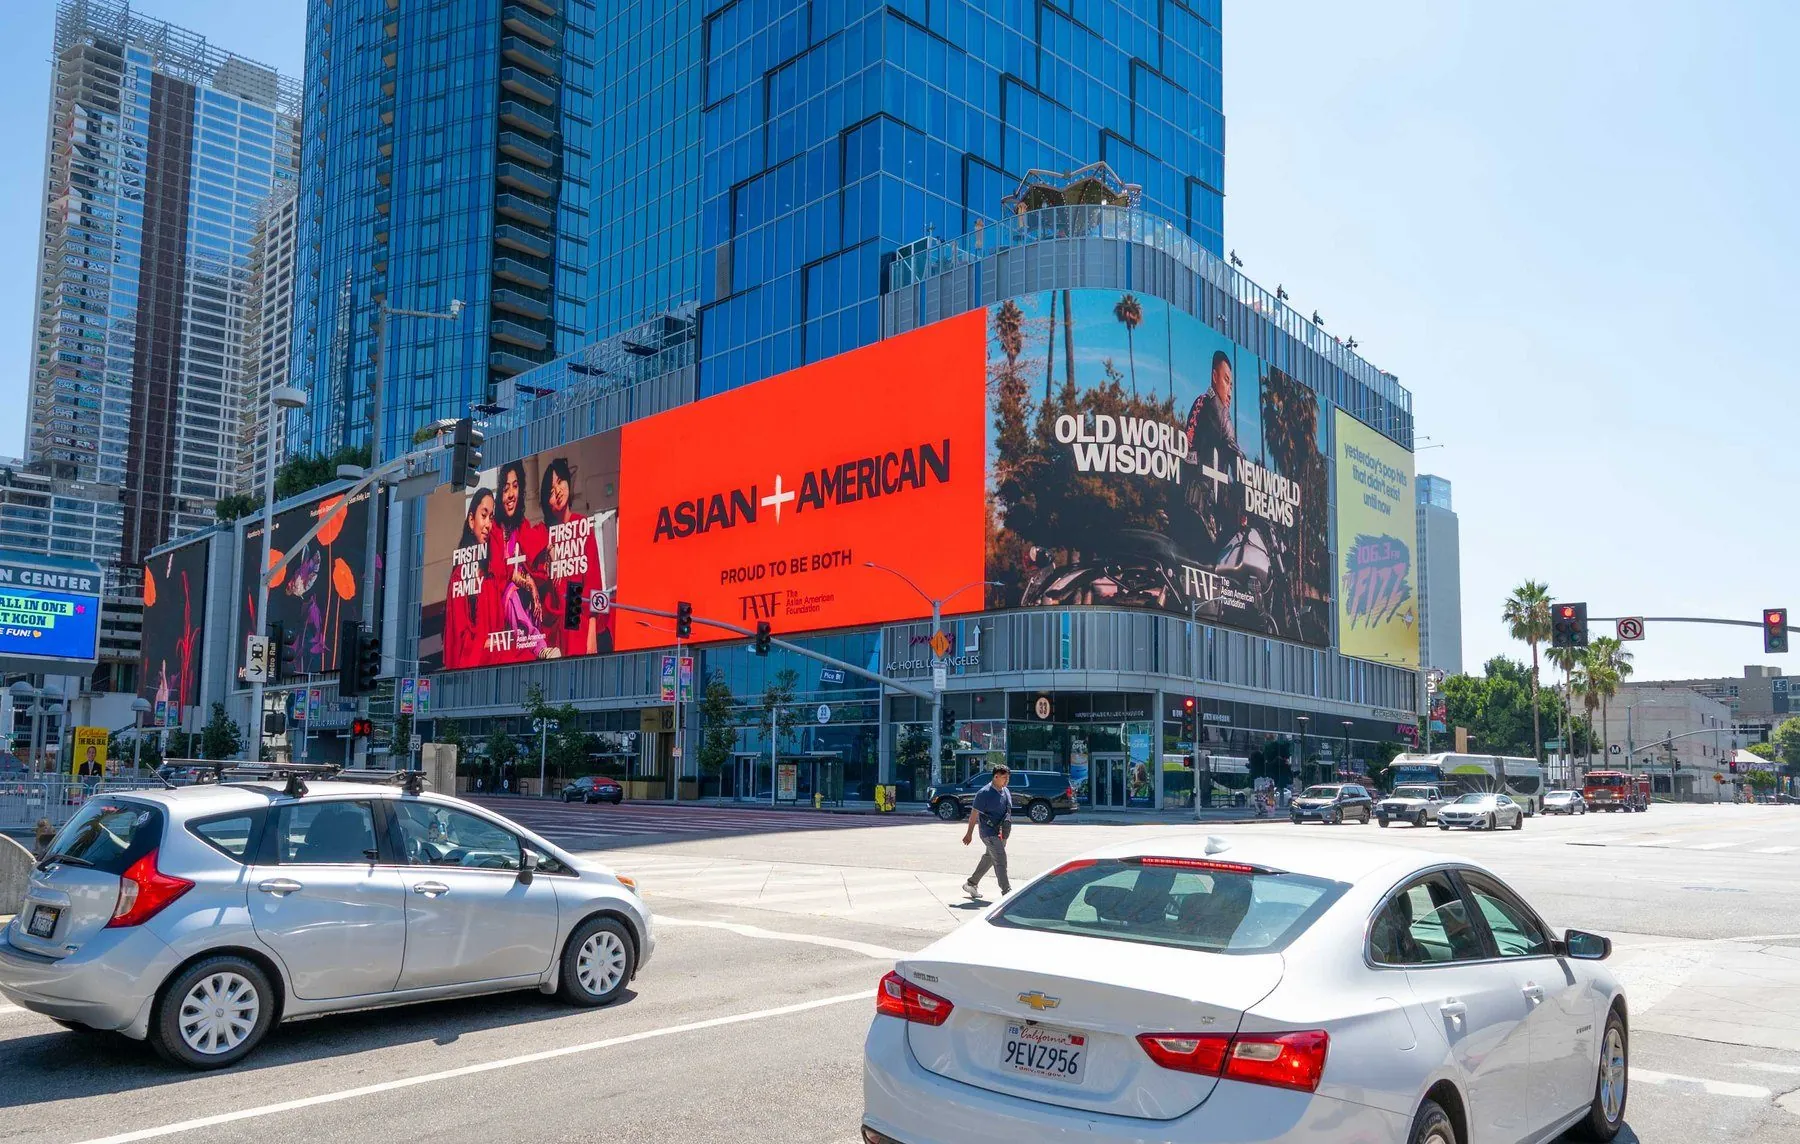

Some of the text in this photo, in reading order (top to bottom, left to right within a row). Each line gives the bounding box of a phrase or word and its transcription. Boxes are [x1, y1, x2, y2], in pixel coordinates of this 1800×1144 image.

[1055, 414, 1189, 460] OLD WORLD
[1073, 443, 1181, 484] WISDOM
[1344, 443, 1407, 487] yesterday's pop hits
[653, 485, 757, 543] ASIAN
[796, 438, 950, 513] AMERICAN
[1236, 456, 1301, 507] NEW WORLD
[1352, 464, 1401, 502] that didn't exist
[1245, 485, 1294, 528] DREAMS
[549, 517, 594, 544] FIRST OF
[453, 543, 488, 567] FIRST IN
[554, 538, 587, 561] MANY
[461, 561, 479, 580] OUR
[550, 556, 588, 579] FIRSTS
[721, 549, 852, 585] PROUD TO BE BOTH
[20, 571, 91, 591] CENTER
[453, 576, 484, 598] FAMILY
[1220, 576, 1230, 587] The
[786, 594, 835, 607] Asian American
[1221, 586, 1255, 603] Asian American
[24, 600, 40, 610] IN
[42, 602, 67, 613] ONE
[786, 604, 821, 615] Foundation
[12, 613, 47, 626] KCON
[6, 628, 31, 637] FUN!
[268, 657, 276, 678] Metro
[886, 661, 899, 671] AC
[899, 659, 924, 670] HOTEL
[943, 655, 980, 666] ANGELES
[824, 672, 834, 680] Pico
[1008, 1026, 1071, 1045] FEB California
[1004, 1040, 1081, 1075] 9EVZ956
